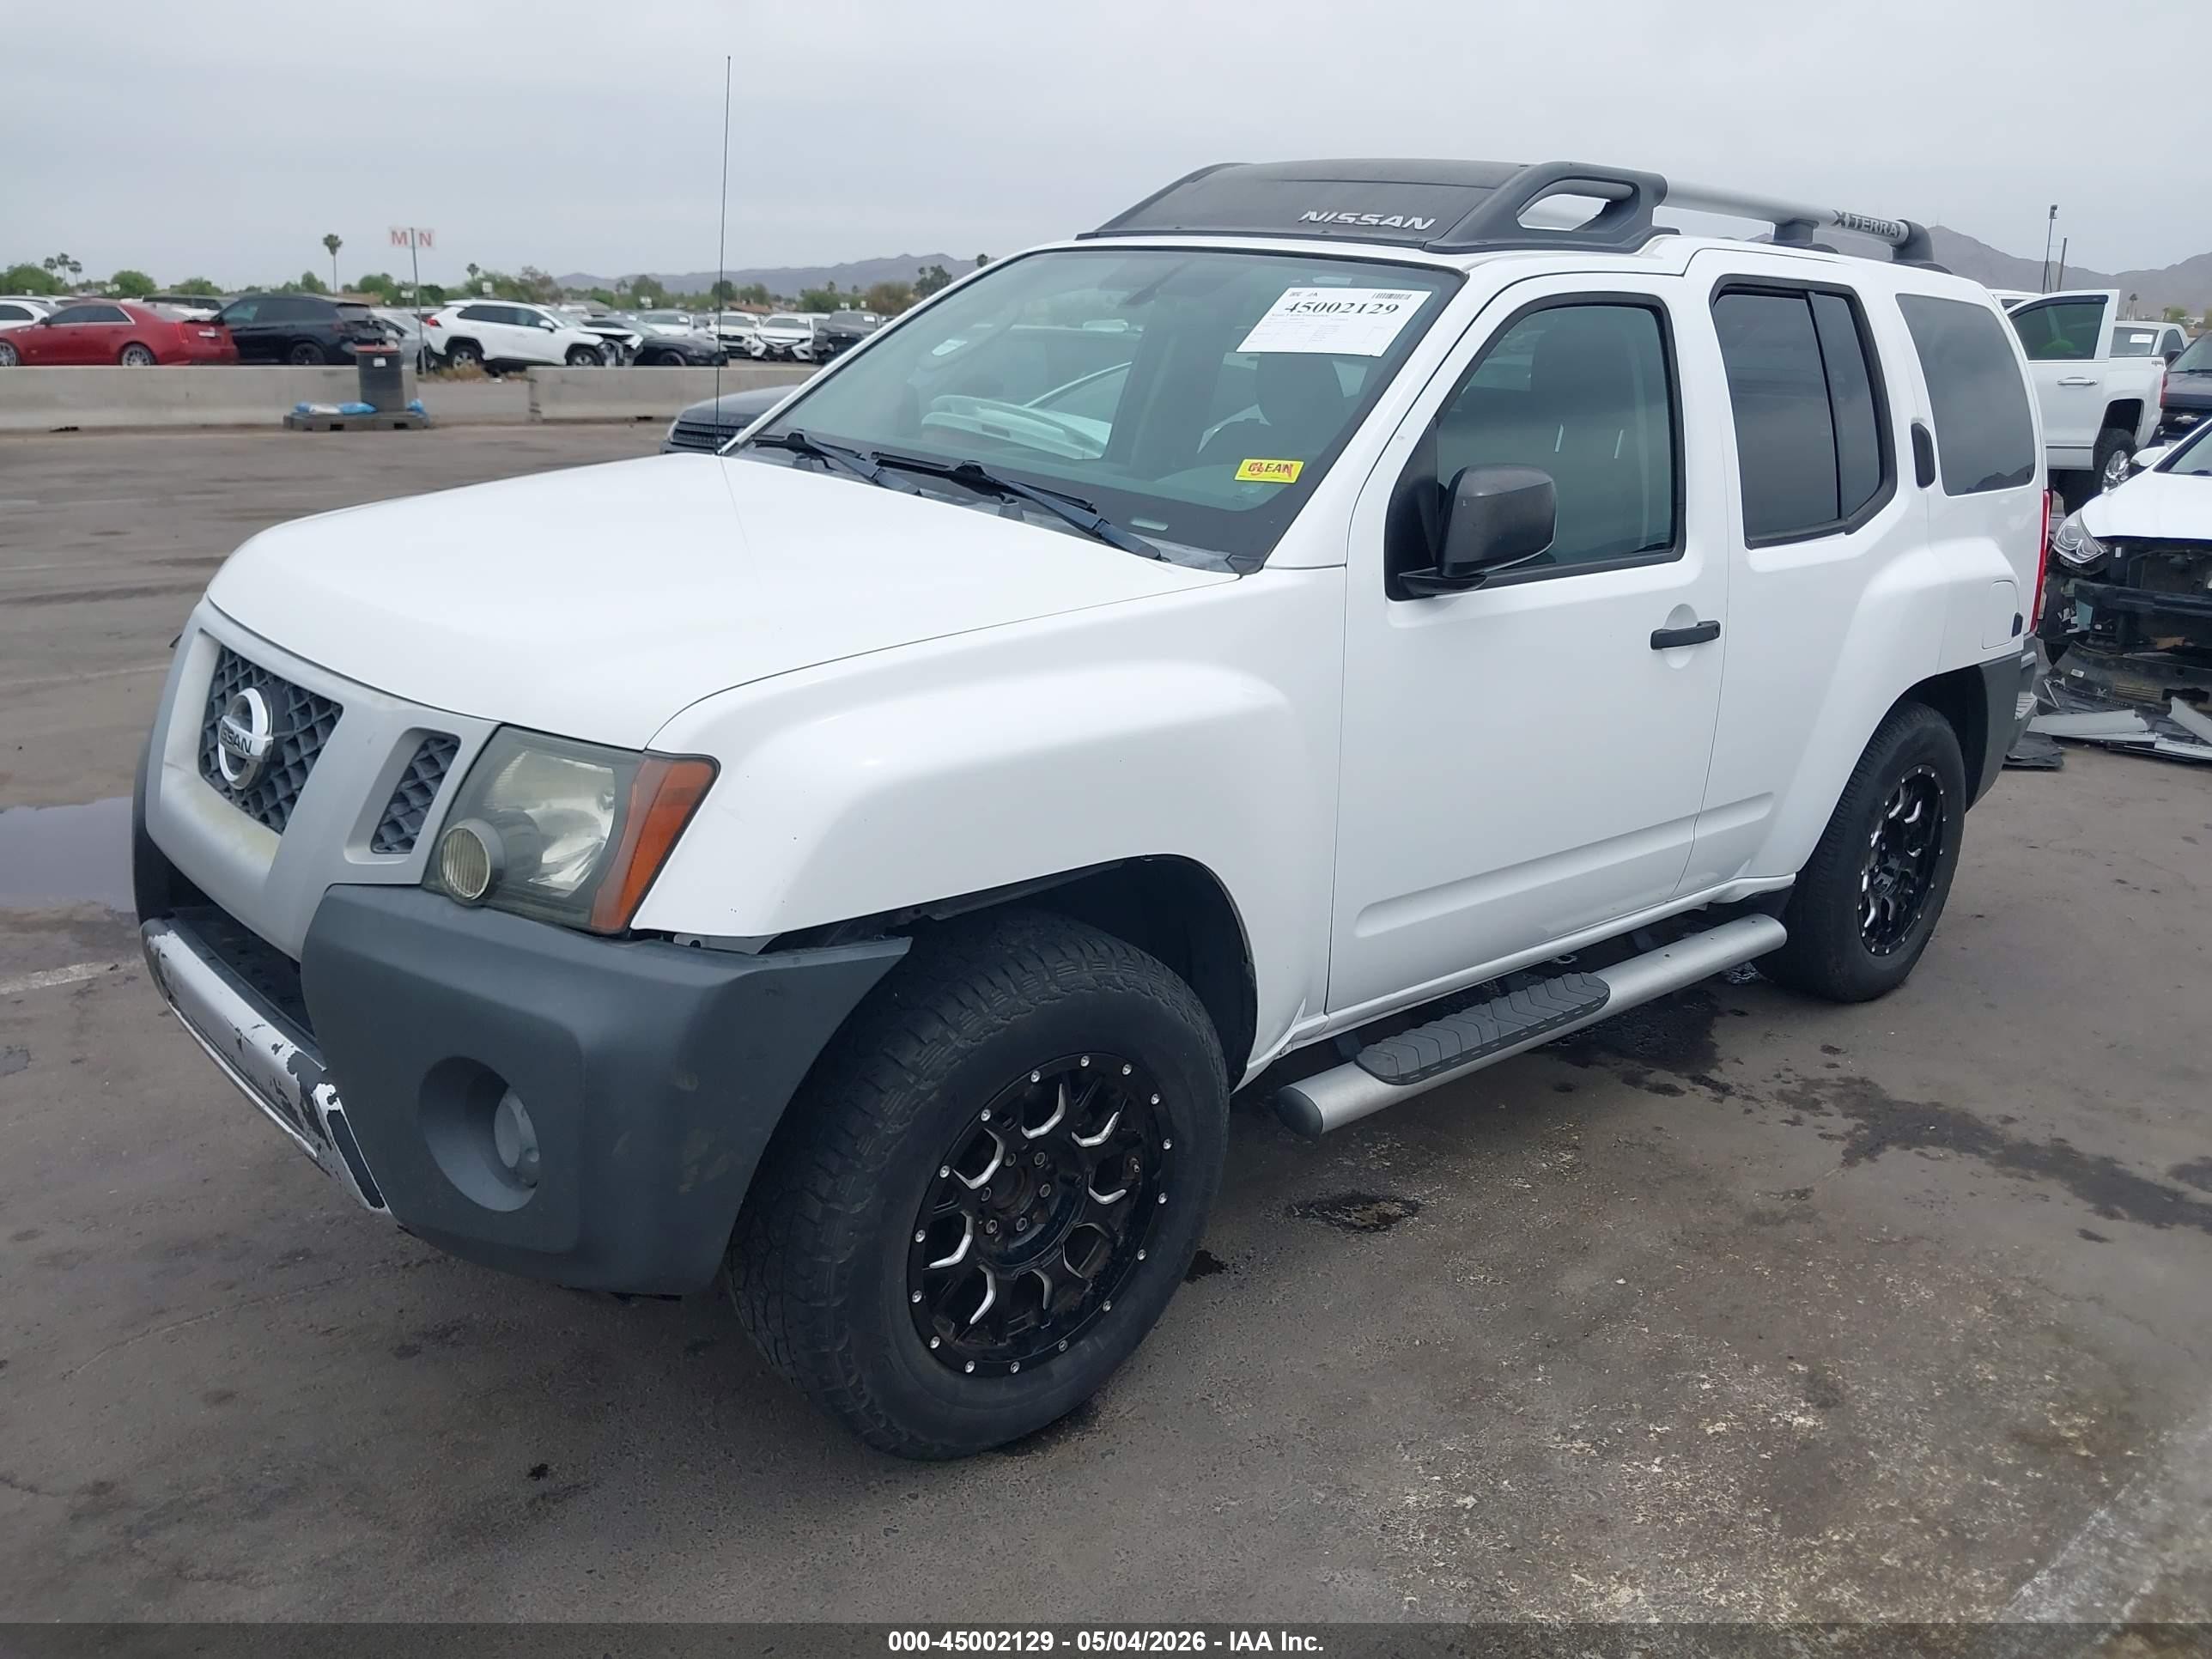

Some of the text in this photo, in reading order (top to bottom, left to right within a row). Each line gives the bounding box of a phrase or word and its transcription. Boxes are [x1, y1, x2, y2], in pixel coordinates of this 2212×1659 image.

[1298, 210, 1436, 230] NISSAN
[392, 231, 407, 246] M
[419, 233, 431, 246] N
[1285, 301, 1400, 315] 45002129
[1248, 463, 1293, 474] CLEAN
